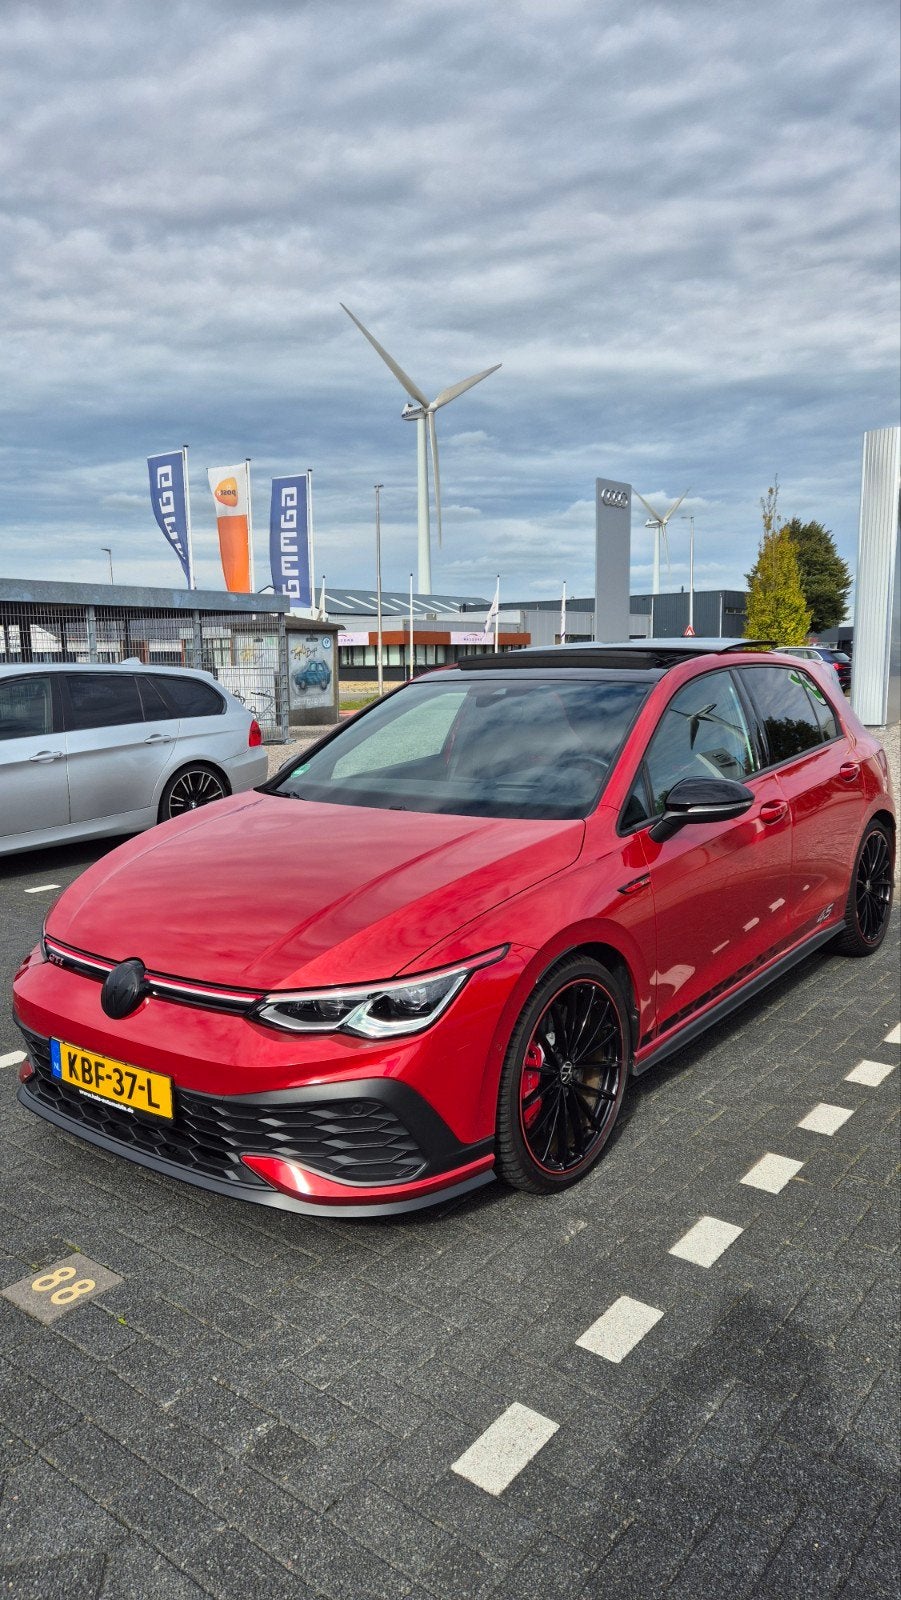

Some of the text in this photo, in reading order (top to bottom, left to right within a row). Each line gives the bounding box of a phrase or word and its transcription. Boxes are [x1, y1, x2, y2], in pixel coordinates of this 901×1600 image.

[48, 953, 65, 966] GTI
[53, 1062, 61, 1072] NL
[68, 1051, 160, 1110] KBF-37-L
[31, 1266, 96, 1305] 88
